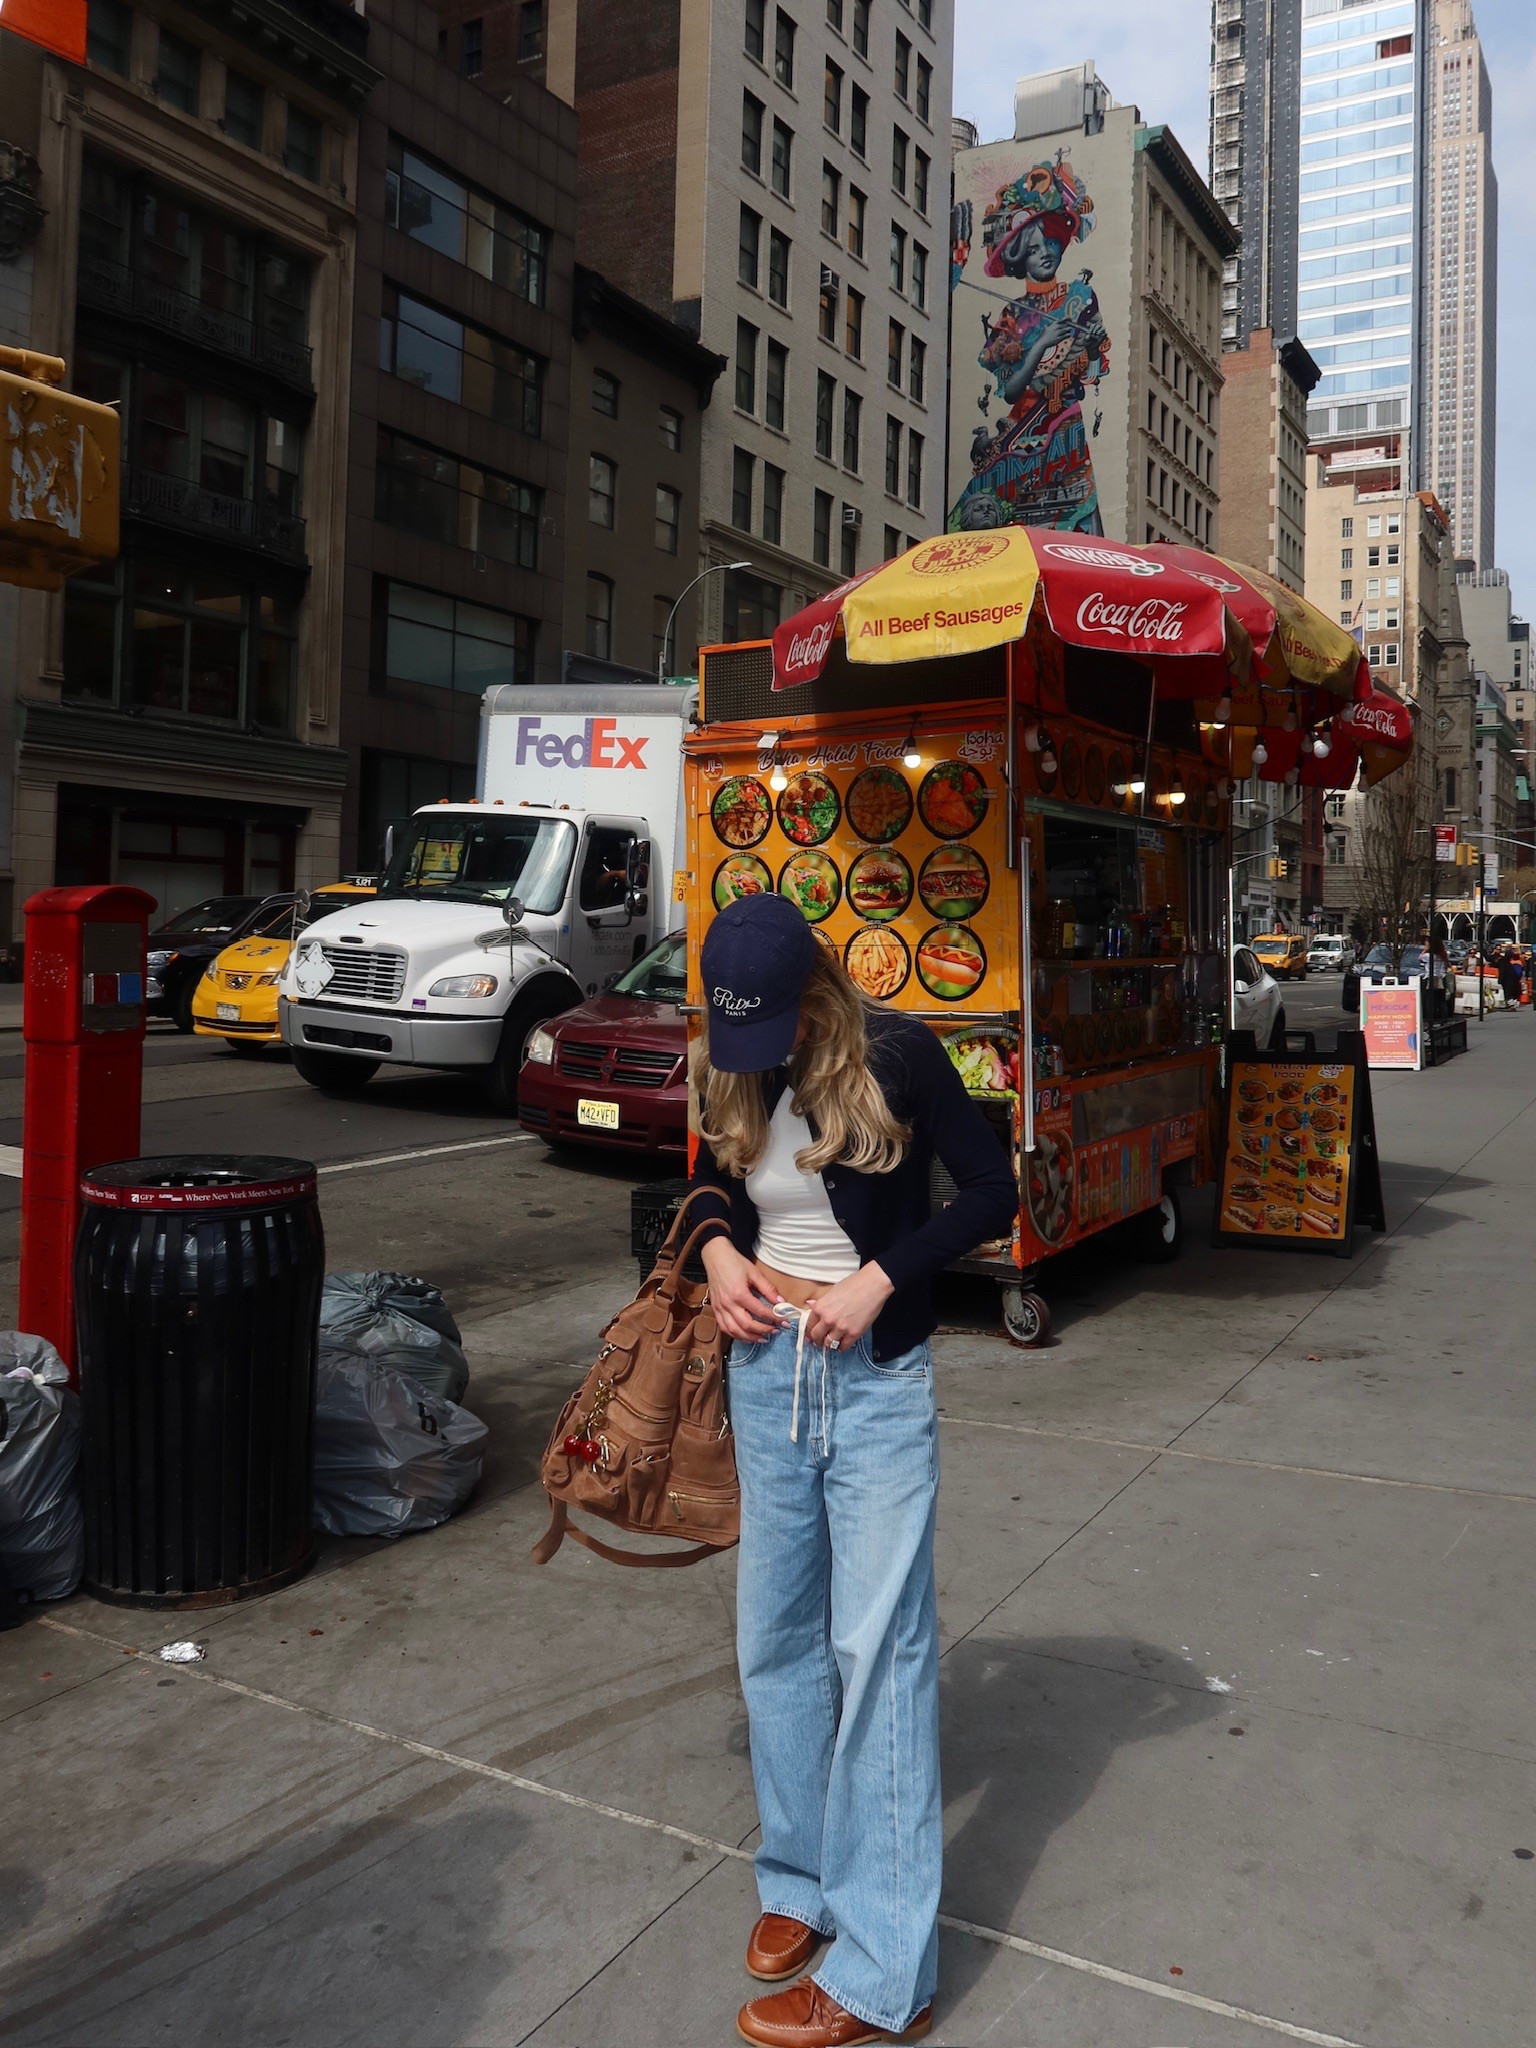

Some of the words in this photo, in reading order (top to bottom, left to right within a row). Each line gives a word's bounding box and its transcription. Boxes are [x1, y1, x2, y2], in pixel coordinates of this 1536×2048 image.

[1057, 547, 1133, 567] NIKAS
[859, 619, 883, 638] All
[889, 612, 931, 635] Beef
[934, 602, 1023, 628] Sausages
[1076, 592, 1188, 641] Coca-Cola
[515, 717, 650, 769] FedEx
[757, 749, 801, 771] Bha
[807, 745, 857, 766] Halal
[861, 741, 907, 764] Food
[185, 1193, 211, 1202] Where
[211, 1192, 229, 1201] New
[231, 1191, 247, 1199] York
[248, 1189, 268, 1198] Meets
